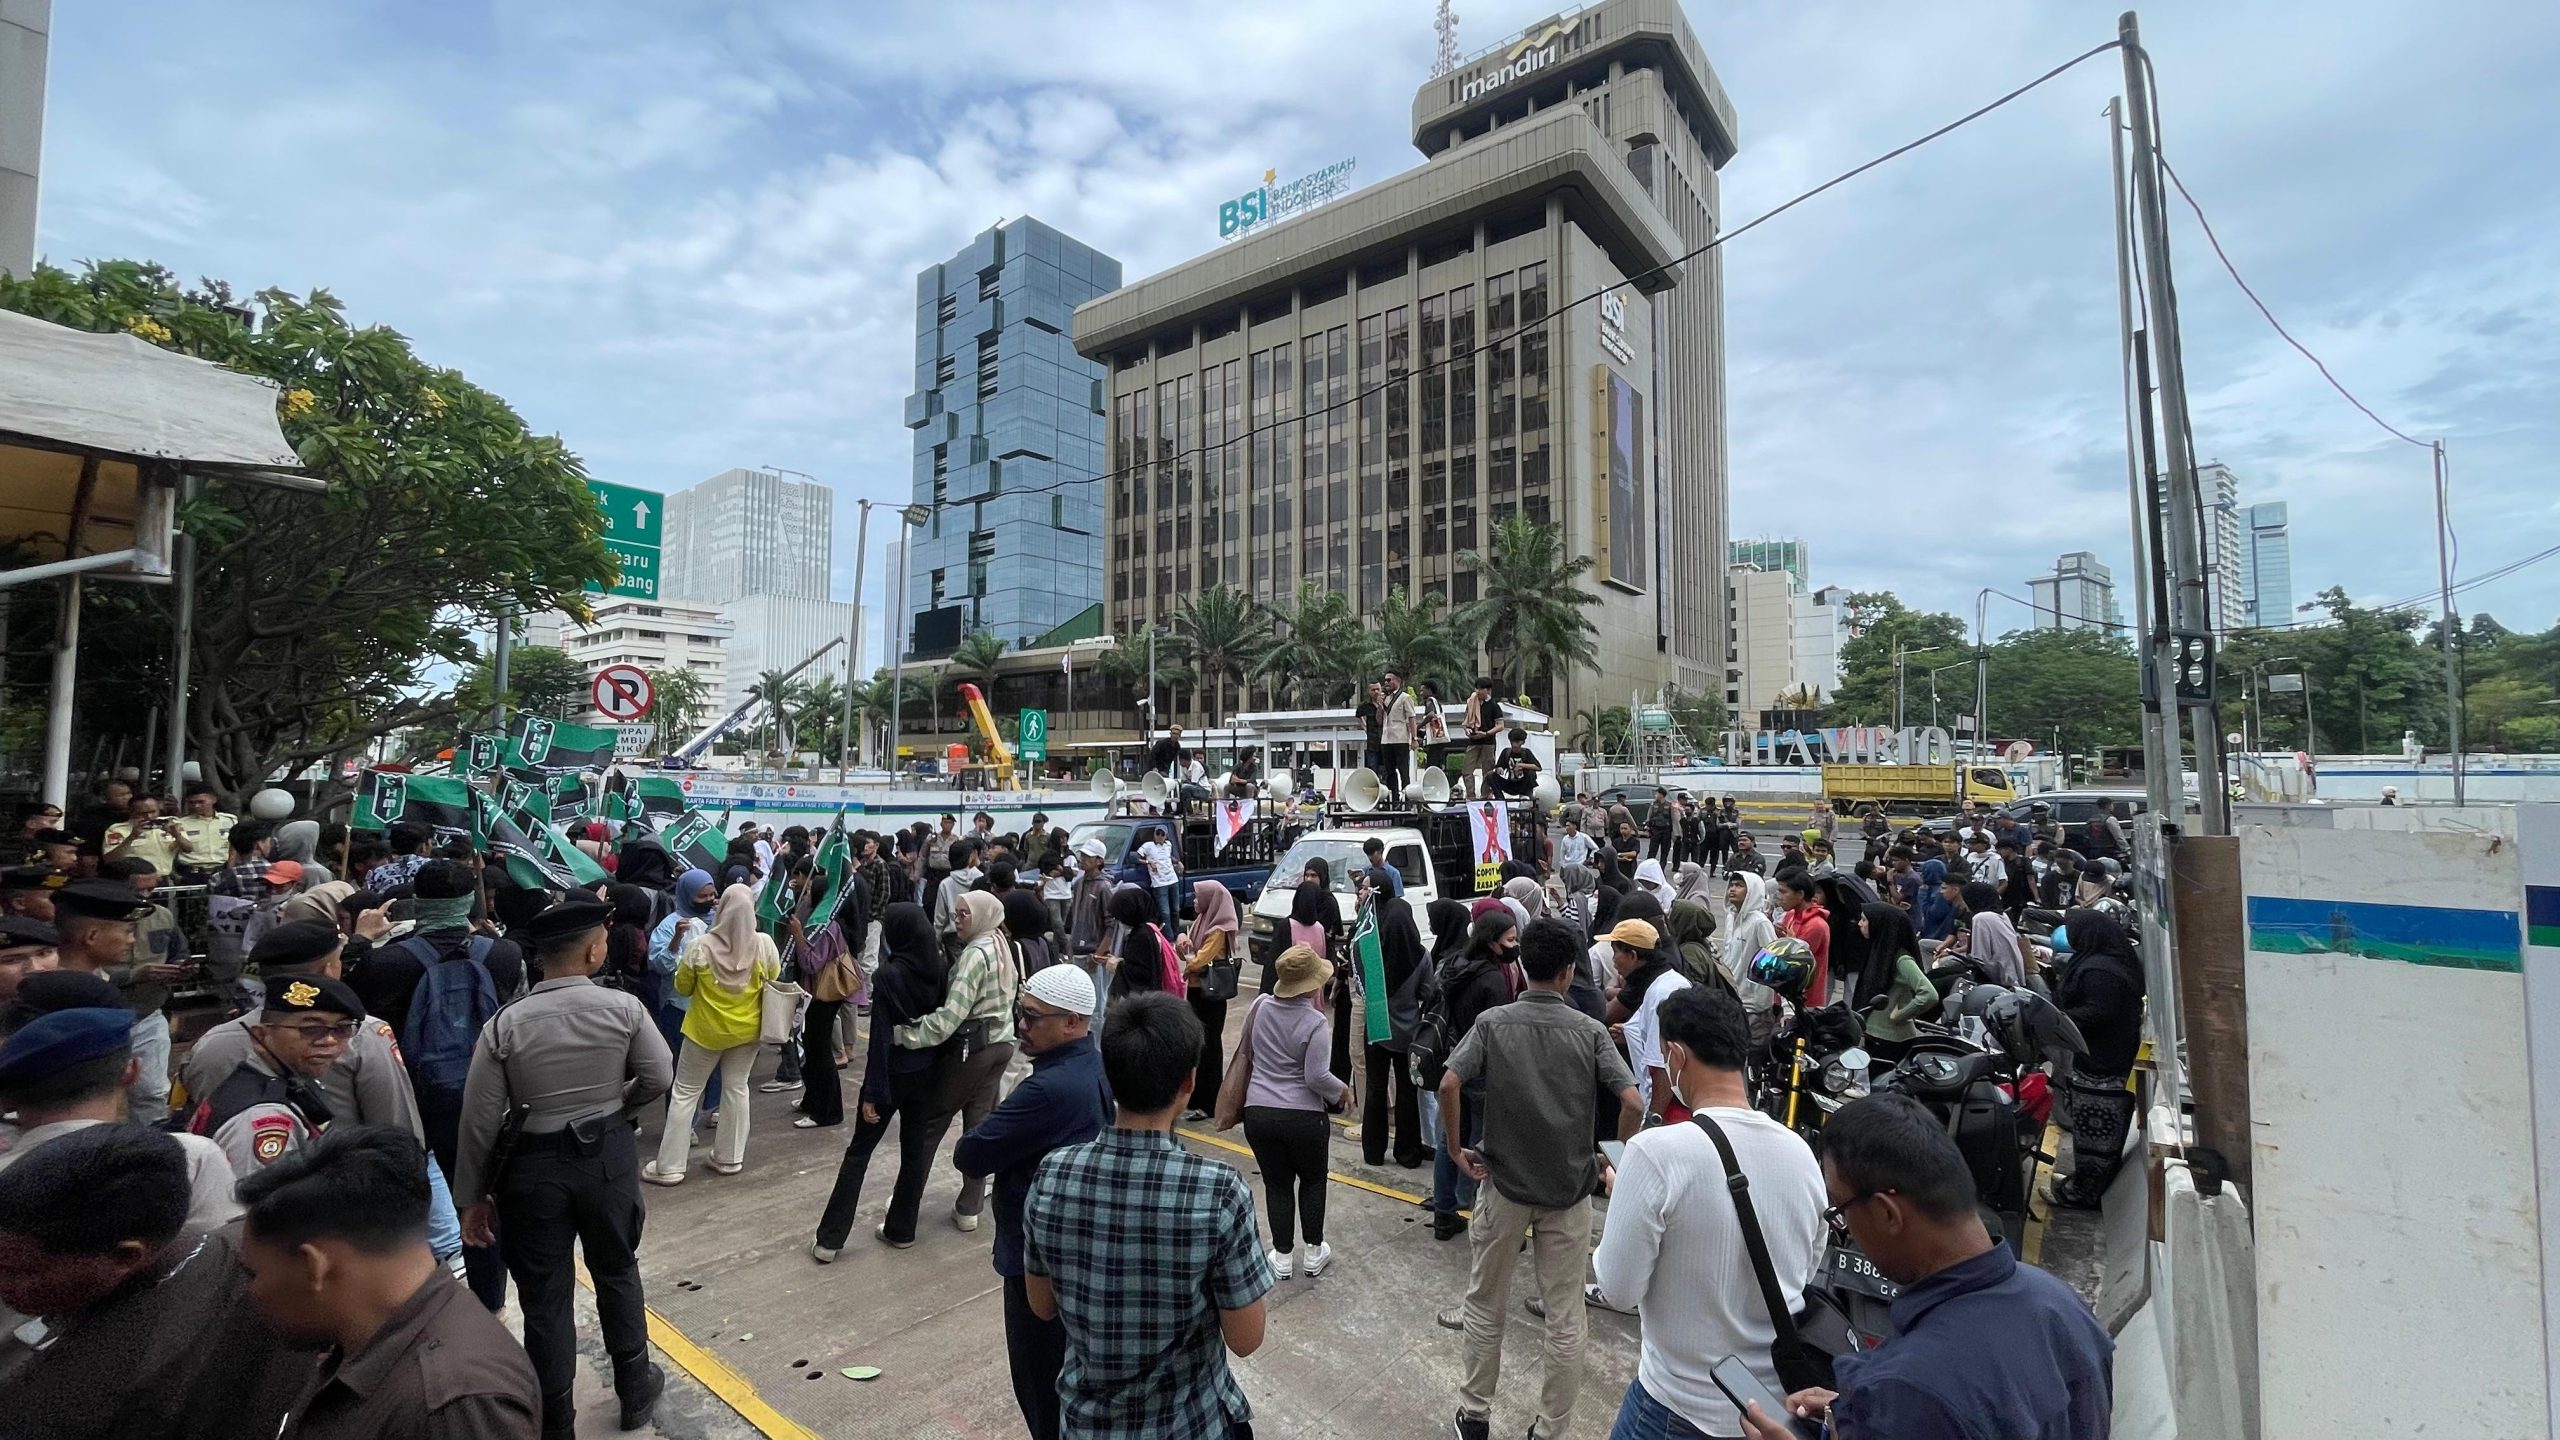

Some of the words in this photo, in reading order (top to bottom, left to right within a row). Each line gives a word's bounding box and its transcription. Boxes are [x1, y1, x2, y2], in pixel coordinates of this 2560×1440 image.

[1463, 45, 1555, 101] mandiri
[1272, 181, 1336, 214] INDONESIA
[1273, 179, 1303, 200] BANK
[1305, 156, 1356, 188] SYARIAH
[1219, 187, 1267, 237] BSI
[1601, 284, 1625, 333] BSI
[617, 573, 654, 595] bang
[1838, 1253, 1847, 1269] B
